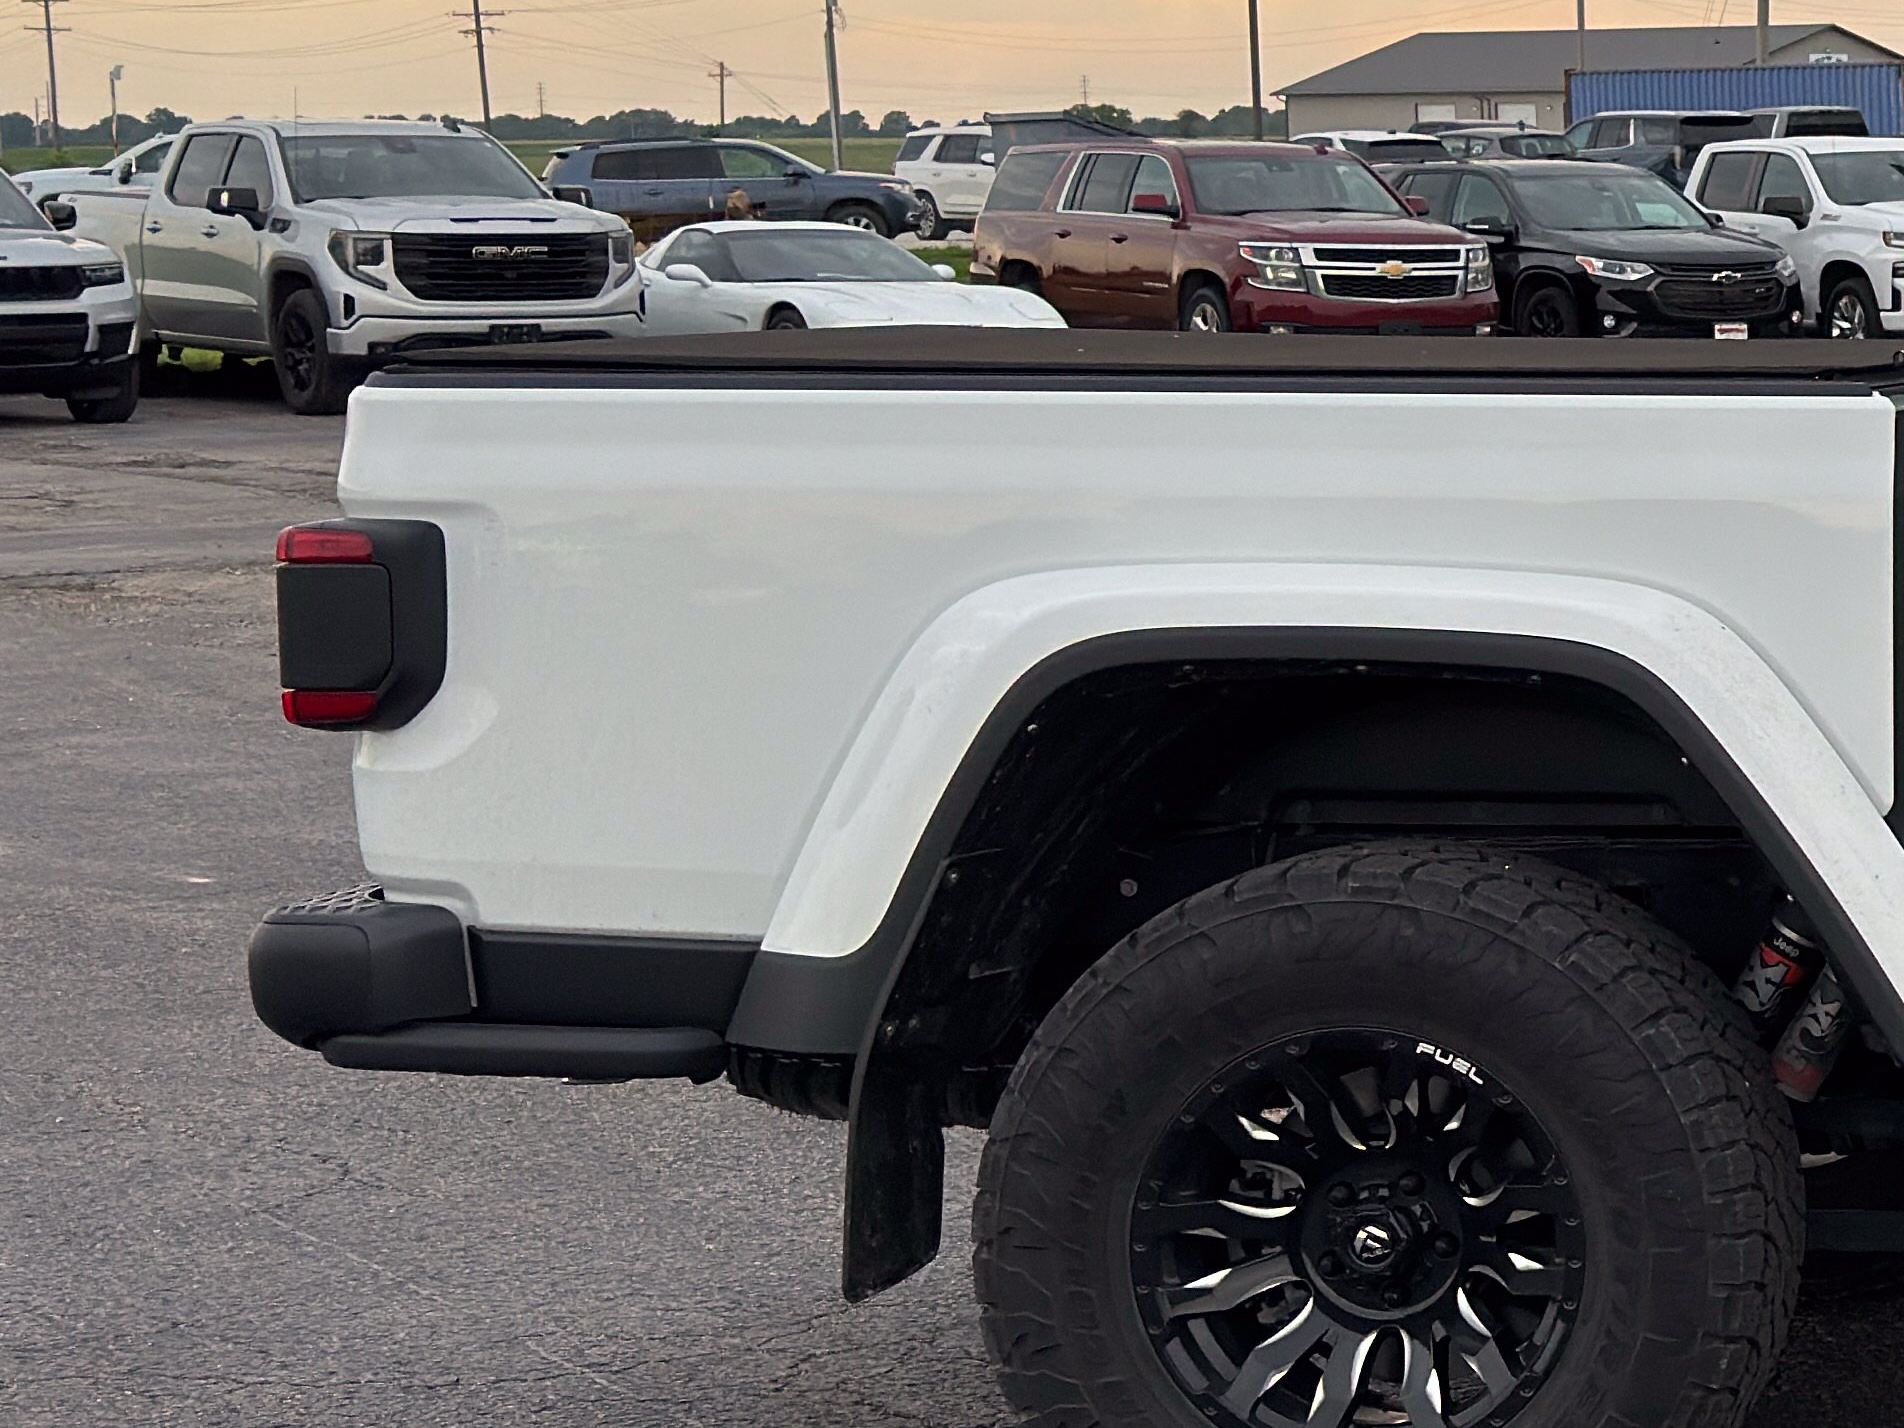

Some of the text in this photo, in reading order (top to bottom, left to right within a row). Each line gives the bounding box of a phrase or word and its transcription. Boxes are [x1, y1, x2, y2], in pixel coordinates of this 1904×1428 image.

[472, 246, 548, 261] GMC
[1773, 936, 1801, 958] Jeep
[1416, 1042, 1484, 1085] FUEL
